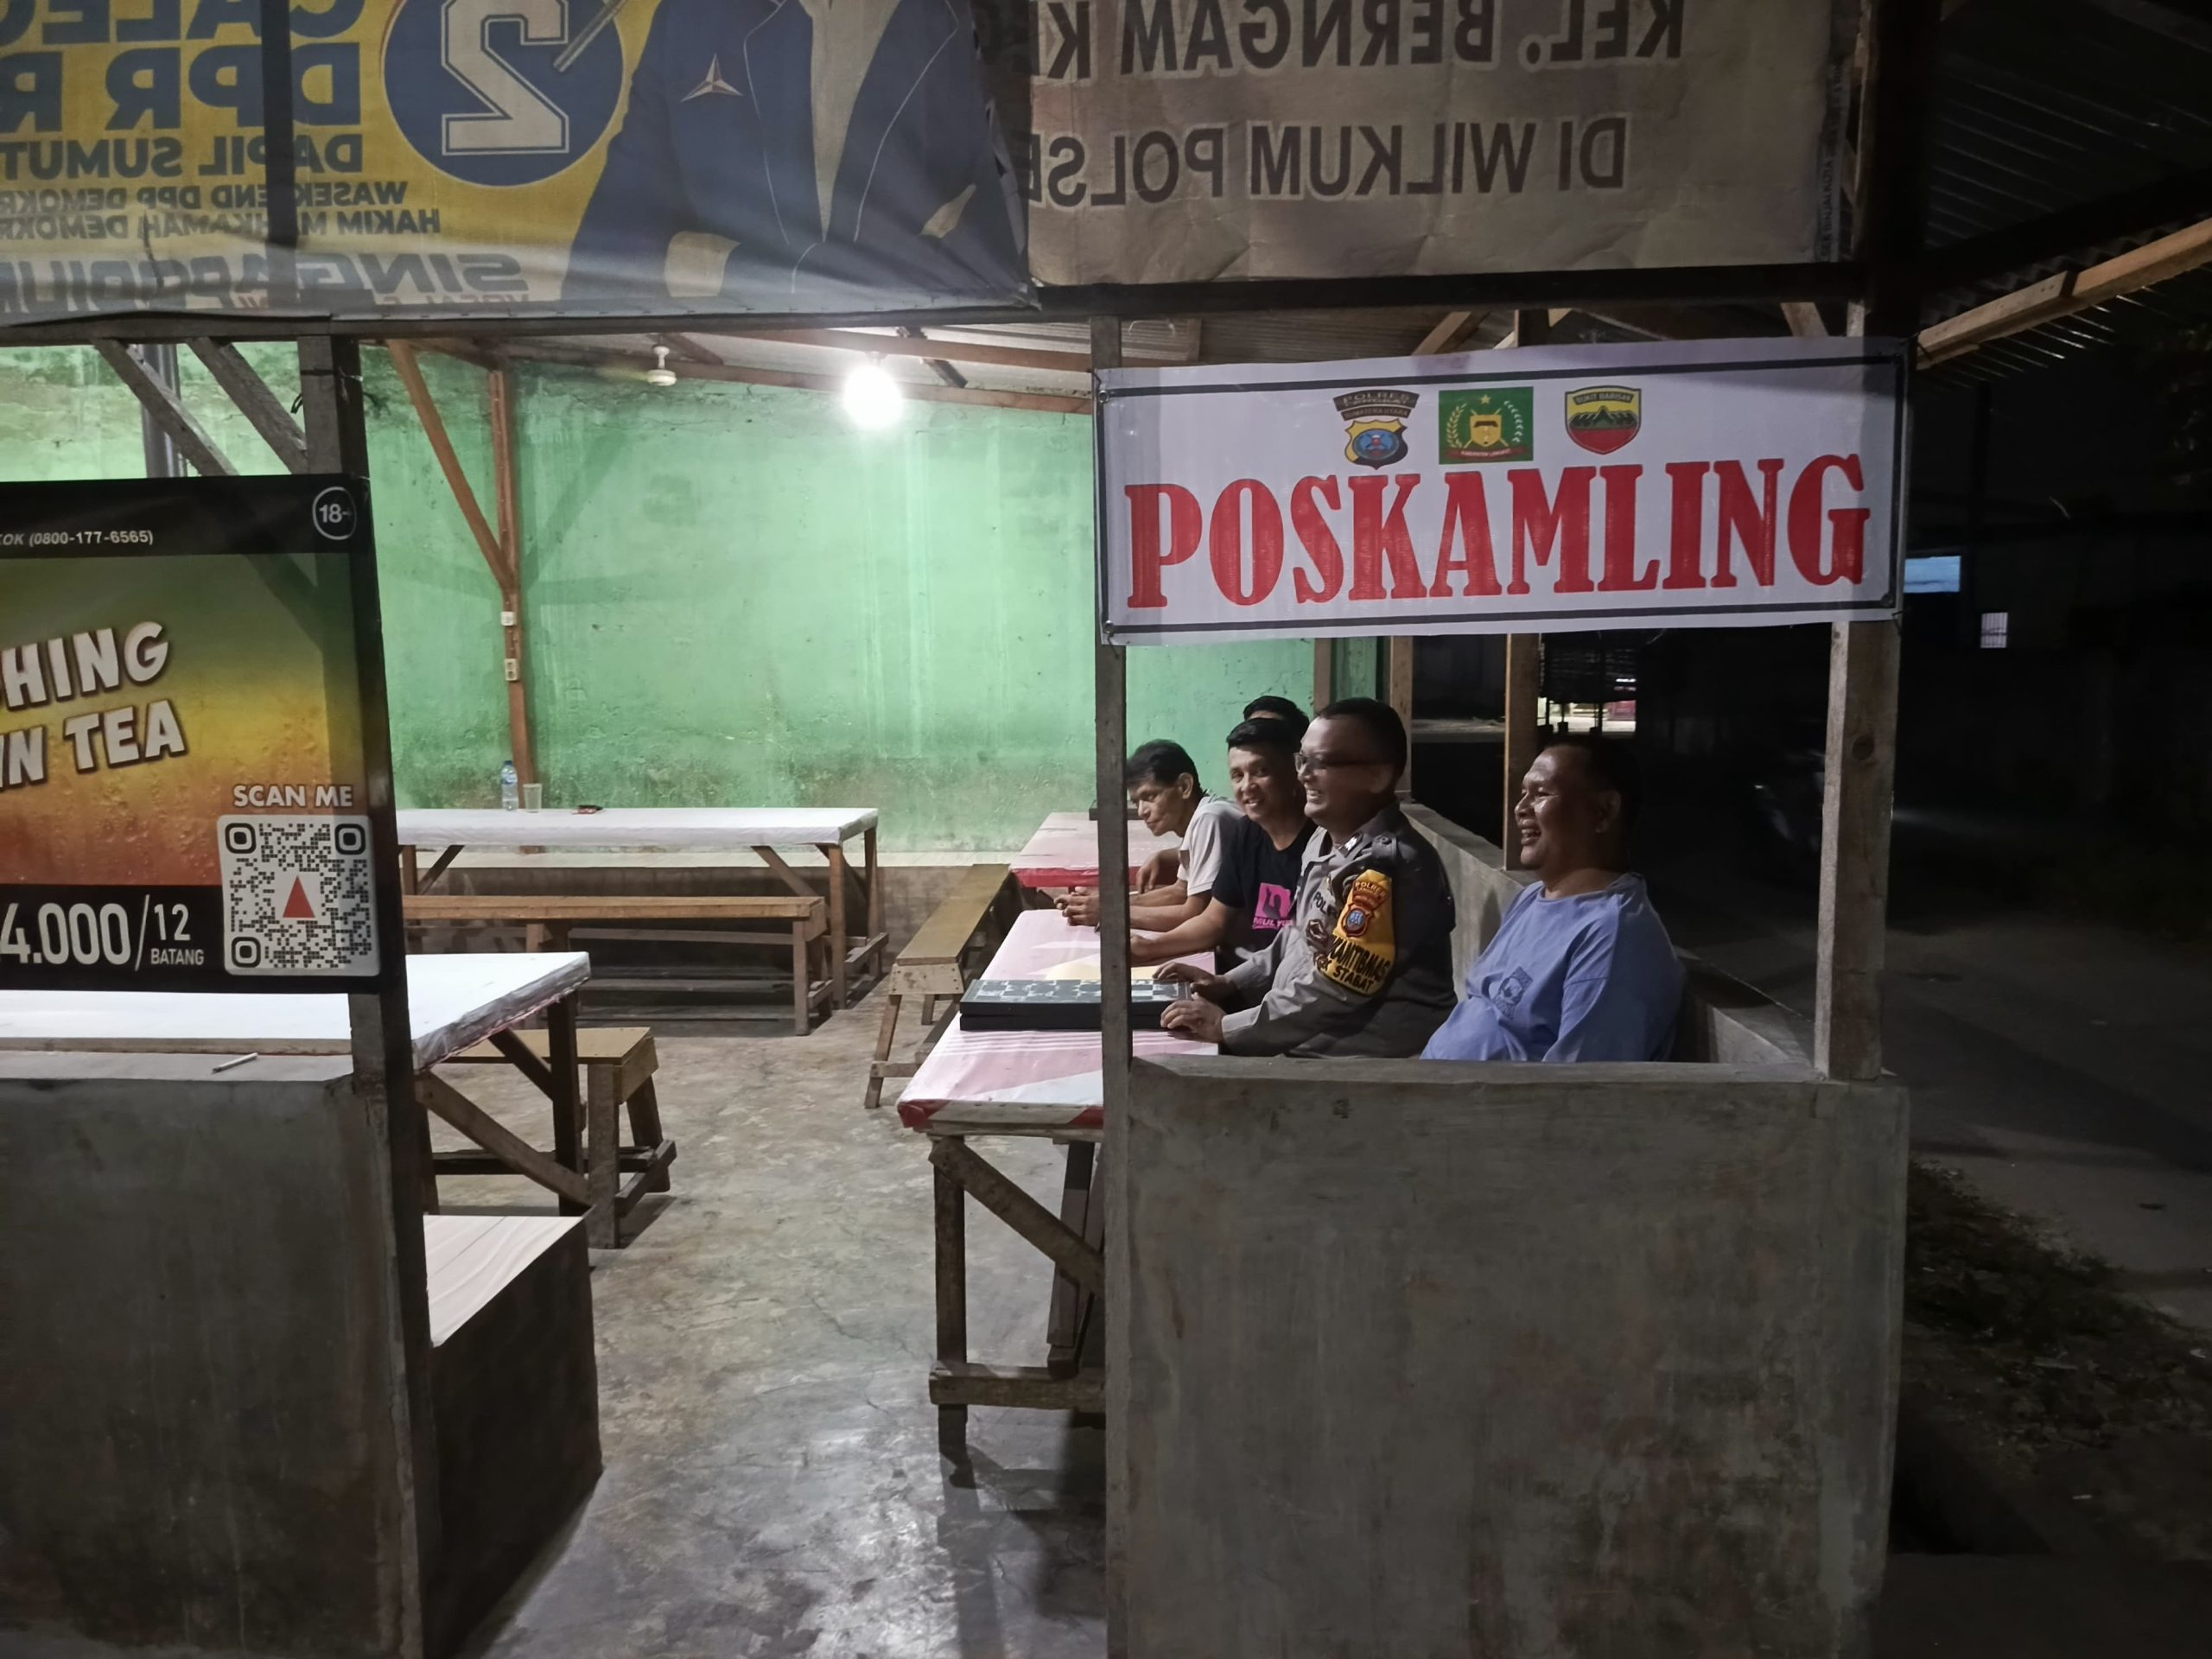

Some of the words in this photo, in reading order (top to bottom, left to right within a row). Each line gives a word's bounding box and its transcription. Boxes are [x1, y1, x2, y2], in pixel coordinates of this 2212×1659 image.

[29, 530, 154, 548] (0800-177-6565)
[1124, 453, 1872, 607] POSKAMLING
[64, 699, 186, 771] TEA
[233, 785, 307, 807] SCAN
[315, 785, 354, 807] ME
[150, 948, 205, 965] BATANG
